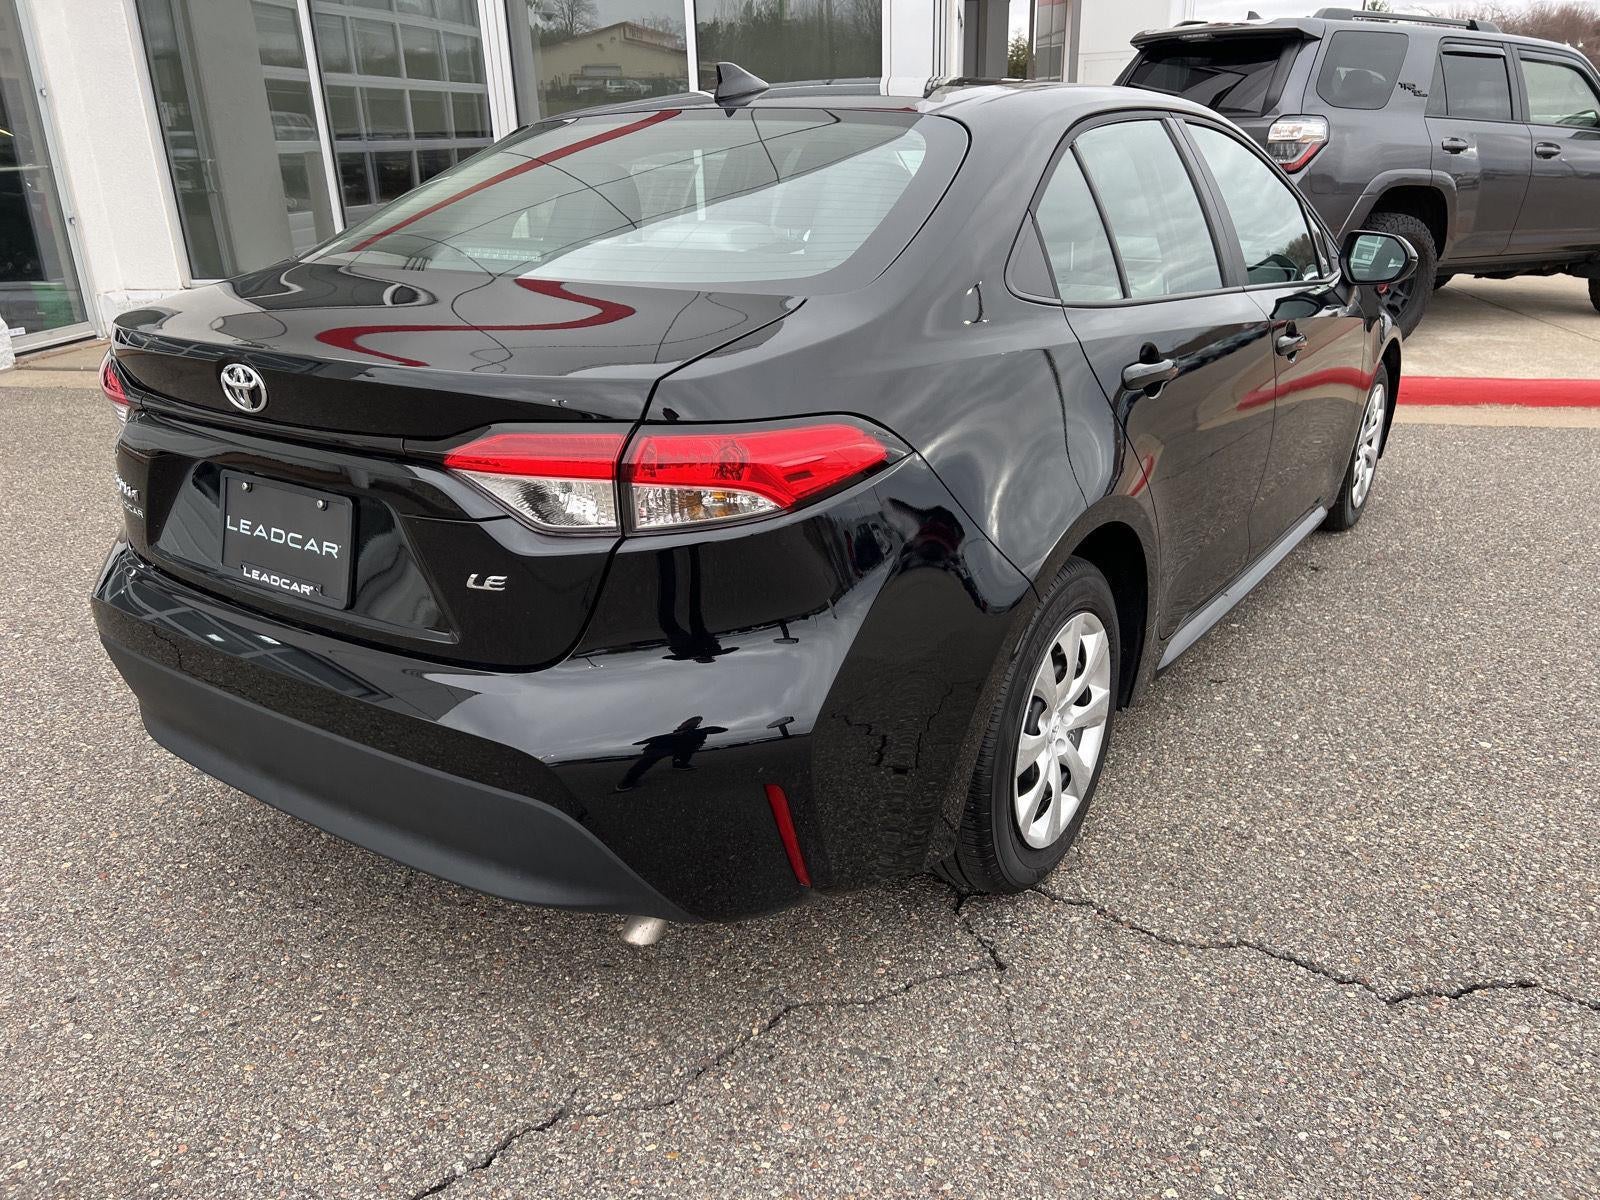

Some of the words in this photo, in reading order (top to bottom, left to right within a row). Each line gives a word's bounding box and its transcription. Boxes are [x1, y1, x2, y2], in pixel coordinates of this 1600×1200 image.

[226, 515, 340, 559] LEADCAR
[243, 565, 312, 596] LEADCAR
[466, 573, 507, 591] LE
